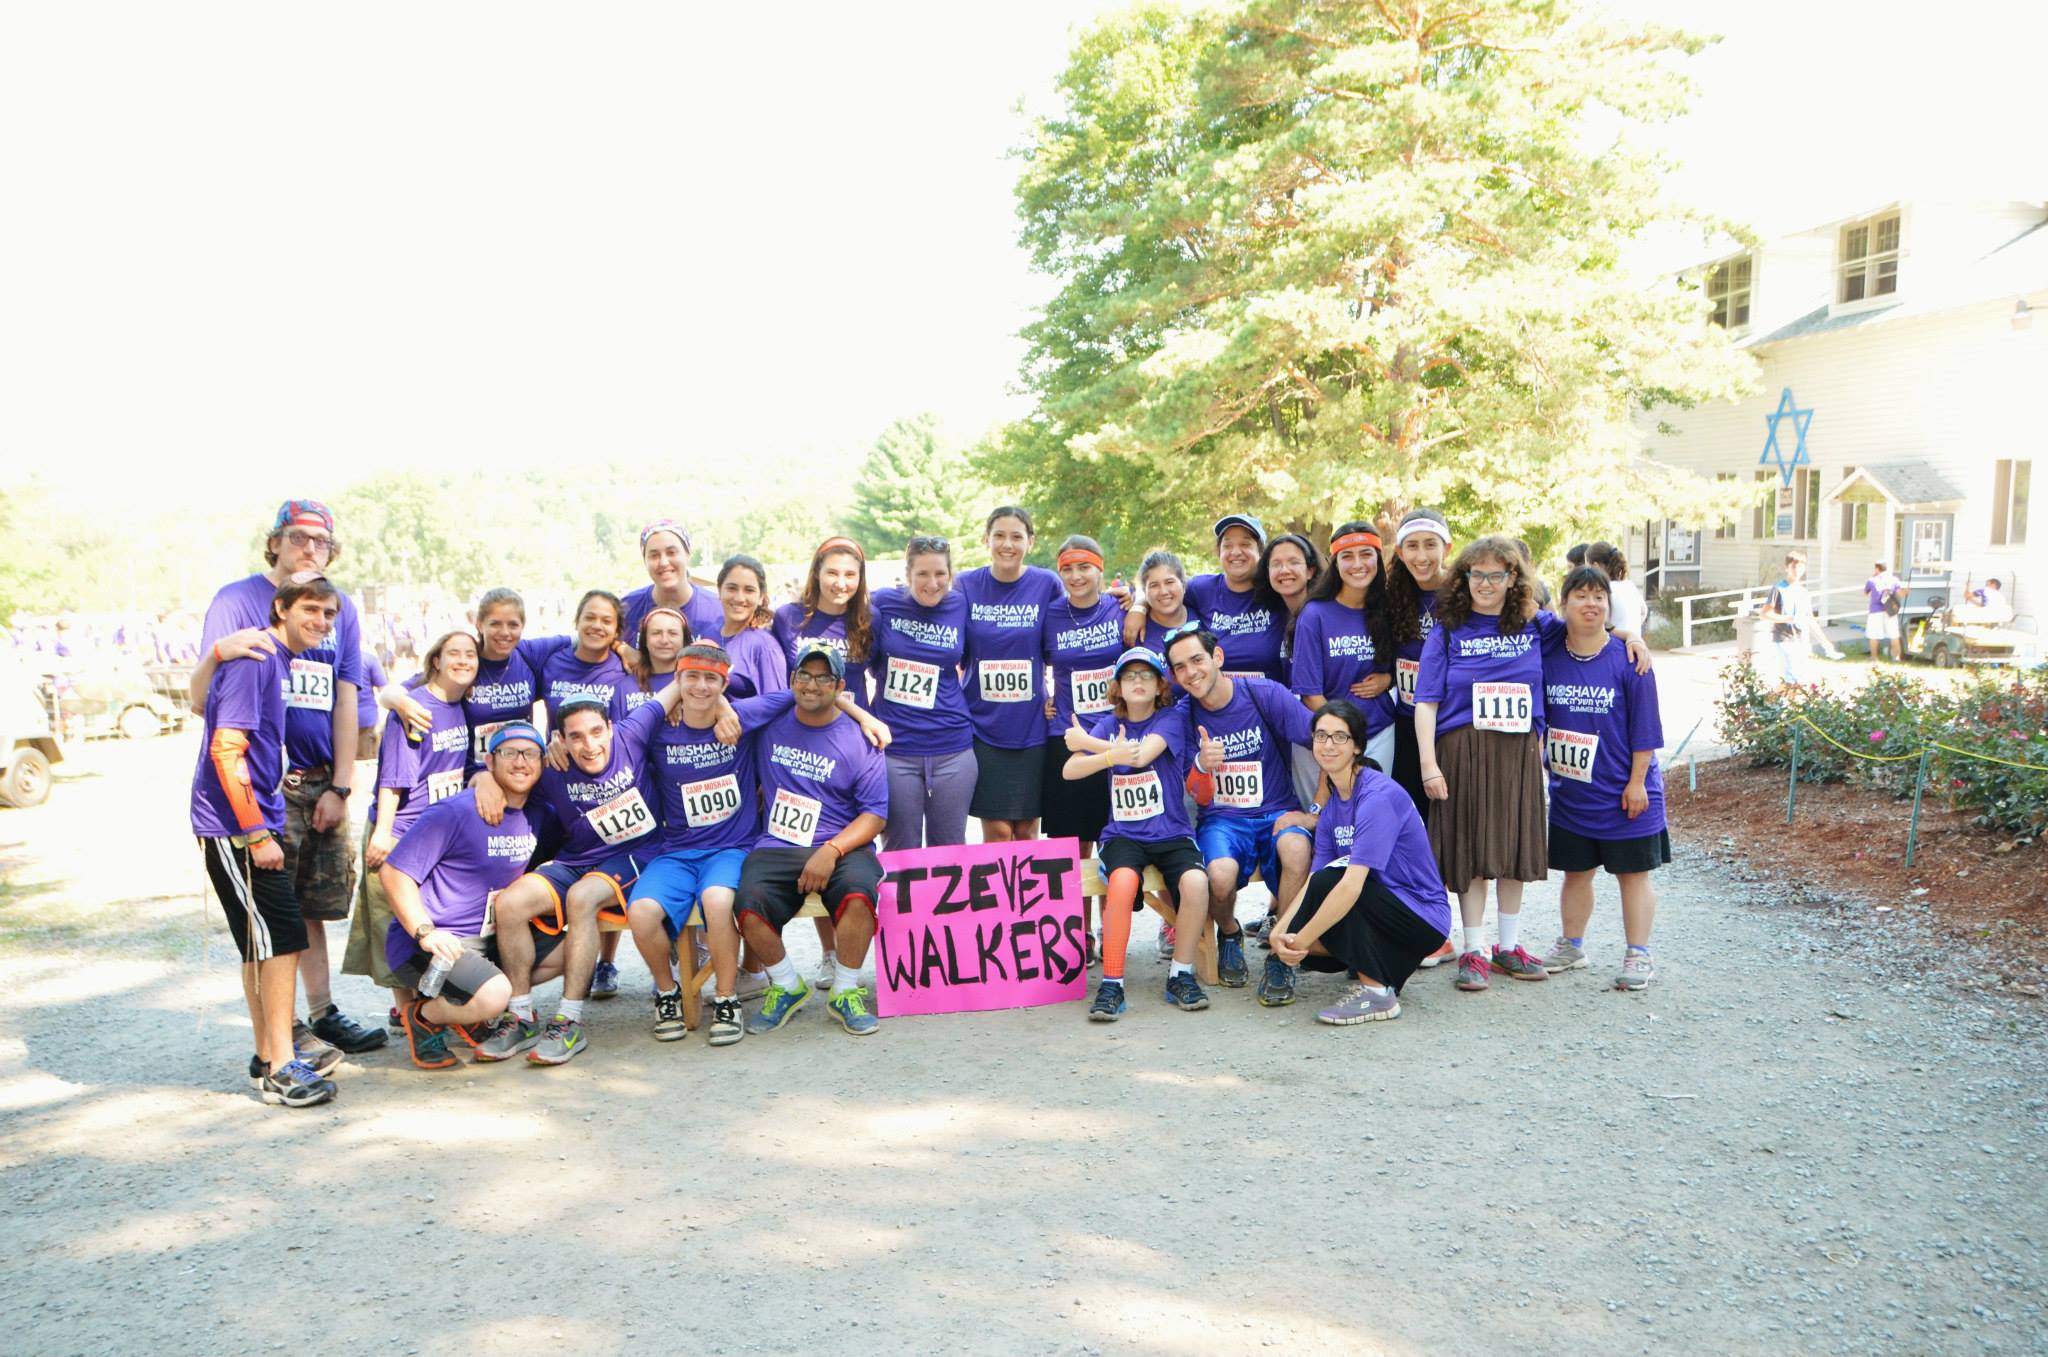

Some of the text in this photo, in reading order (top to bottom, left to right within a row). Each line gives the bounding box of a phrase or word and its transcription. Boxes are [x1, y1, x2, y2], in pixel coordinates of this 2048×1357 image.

[972, 603, 1033, 616] MOSHAVA
[1057, 621, 1114, 644] MOSHAVA
[1329, 635, 1373, 649] MOSHA
[1461, 634, 1528, 649] MOSHAVA
[1329, 647, 1357, 657] 5K/10K
[891, 660, 935, 675] CAMP MOSHAVA
[984, 663, 1028, 671] CAMP MOSHAVA
[1075, 673, 1091, 681] CAMP
[888, 671, 933, 697] 1124
[984, 672, 1028, 691] 1096
[1478, 685, 1496, 695] CAMP
[1076, 681, 1108, 703] 109
[1547, 685, 1609, 700] MOSHAVA
[1479, 697, 1528, 719] 1116
[1570, 705, 1608, 714] SUMMER 2015
[1552, 731, 1593, 746] CAMP MOSHAVA
[773, 744, 829, 769] MOSHAVA
[1551, 742, 1590, 769] 1118
[1229, 764, 1257, 772] MOSHAVA
[566, 770, 630, 795] MOSHAVA
[685, 778, 732, 794] CAMP MOSHAVA
[1216, 775, 1257, 795] 1099
[688, 788, 737, 816] 1090
[1115, 784, 1158, 808] 1094
[592, 794, 636, 819] CAMP MOSHAVA
[597, 802, 646, 837] 1126
[771, 802, 813, 833] 1120
[885, 855, 1073, 917] TZEVET
[880, 914, 1085, 992] WALKERS
